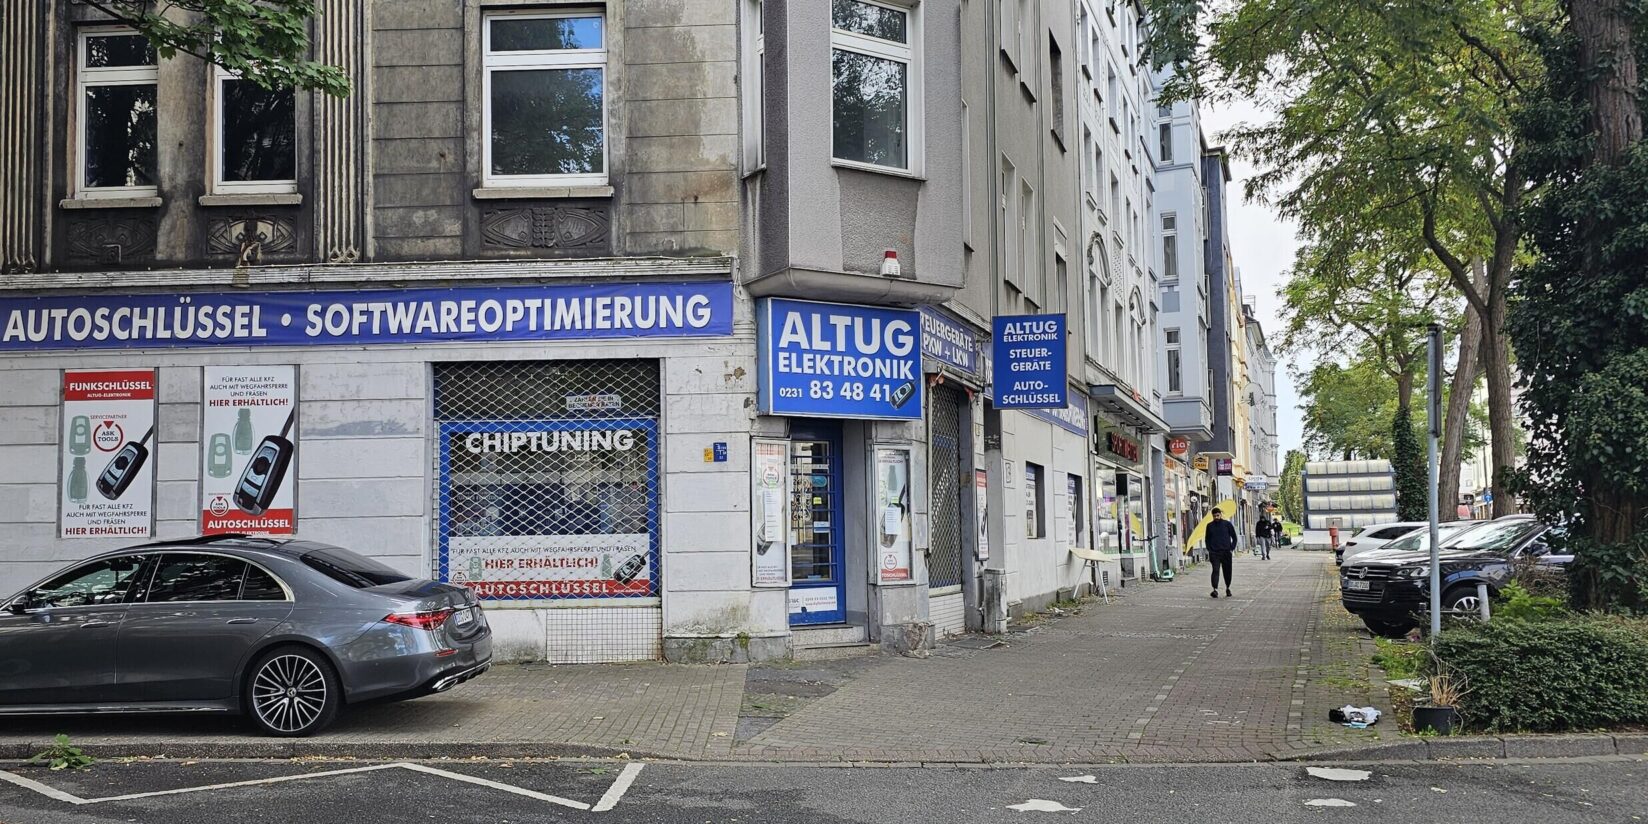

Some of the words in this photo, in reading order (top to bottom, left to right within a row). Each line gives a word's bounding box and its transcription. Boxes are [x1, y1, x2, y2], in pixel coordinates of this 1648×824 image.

[3, 296, 267, 342] AUTOSCHLÜSSEL
[305, 294, 712, 339] SOFTWAREOPTIMIERUNG
[778, 311, 914, 357] ALTUG
[921, 312, 973, 352] TEUERGERÄTE
[1004, 321, 1058, 335] ALTUG
[1003, 333, 1058, 343] ELEKTRONIK
[922, 333, 942, 357] PKW
[952, 347, 968, 367] LKW
[1009, 347, 1052, 359] STEUER-
[778, 351, 915, 380] ELEKTRONIK
[1010, 359, 1051, 372] GERÄTE
[69, 379, 152, 391] FUNKSCHLÜSSEL
[779, 386, 803, 398] 0231
[809, 380, 833, 400] 83
[840, 381, 864, 401] 48
[870, 382, 890, 402] 41
[1013, 381, 1049, 391] AUTO-
[209, 399, 230, 407] HIER
[232, 398, 288, 407] ERHÄLTLICH!
[1002, 391, 1061, 404] SCHLÜSSEL
[465, 429, 634, 453] CHIPTUNING
[1171, 439, 1186, 449] ria
[207, 517, 290, 529] AUTOSCHLÜSSEL
[65, 527, 87, 535] HIER
[89, 525, 147, 535] ERHÄLTLICH!
[484, 557, 514, 569] HIER
[518, 555, 599, 568] ERHÄLTLICH!
[474, 580, 609, 594] AUTOSCHLÜSSEL
